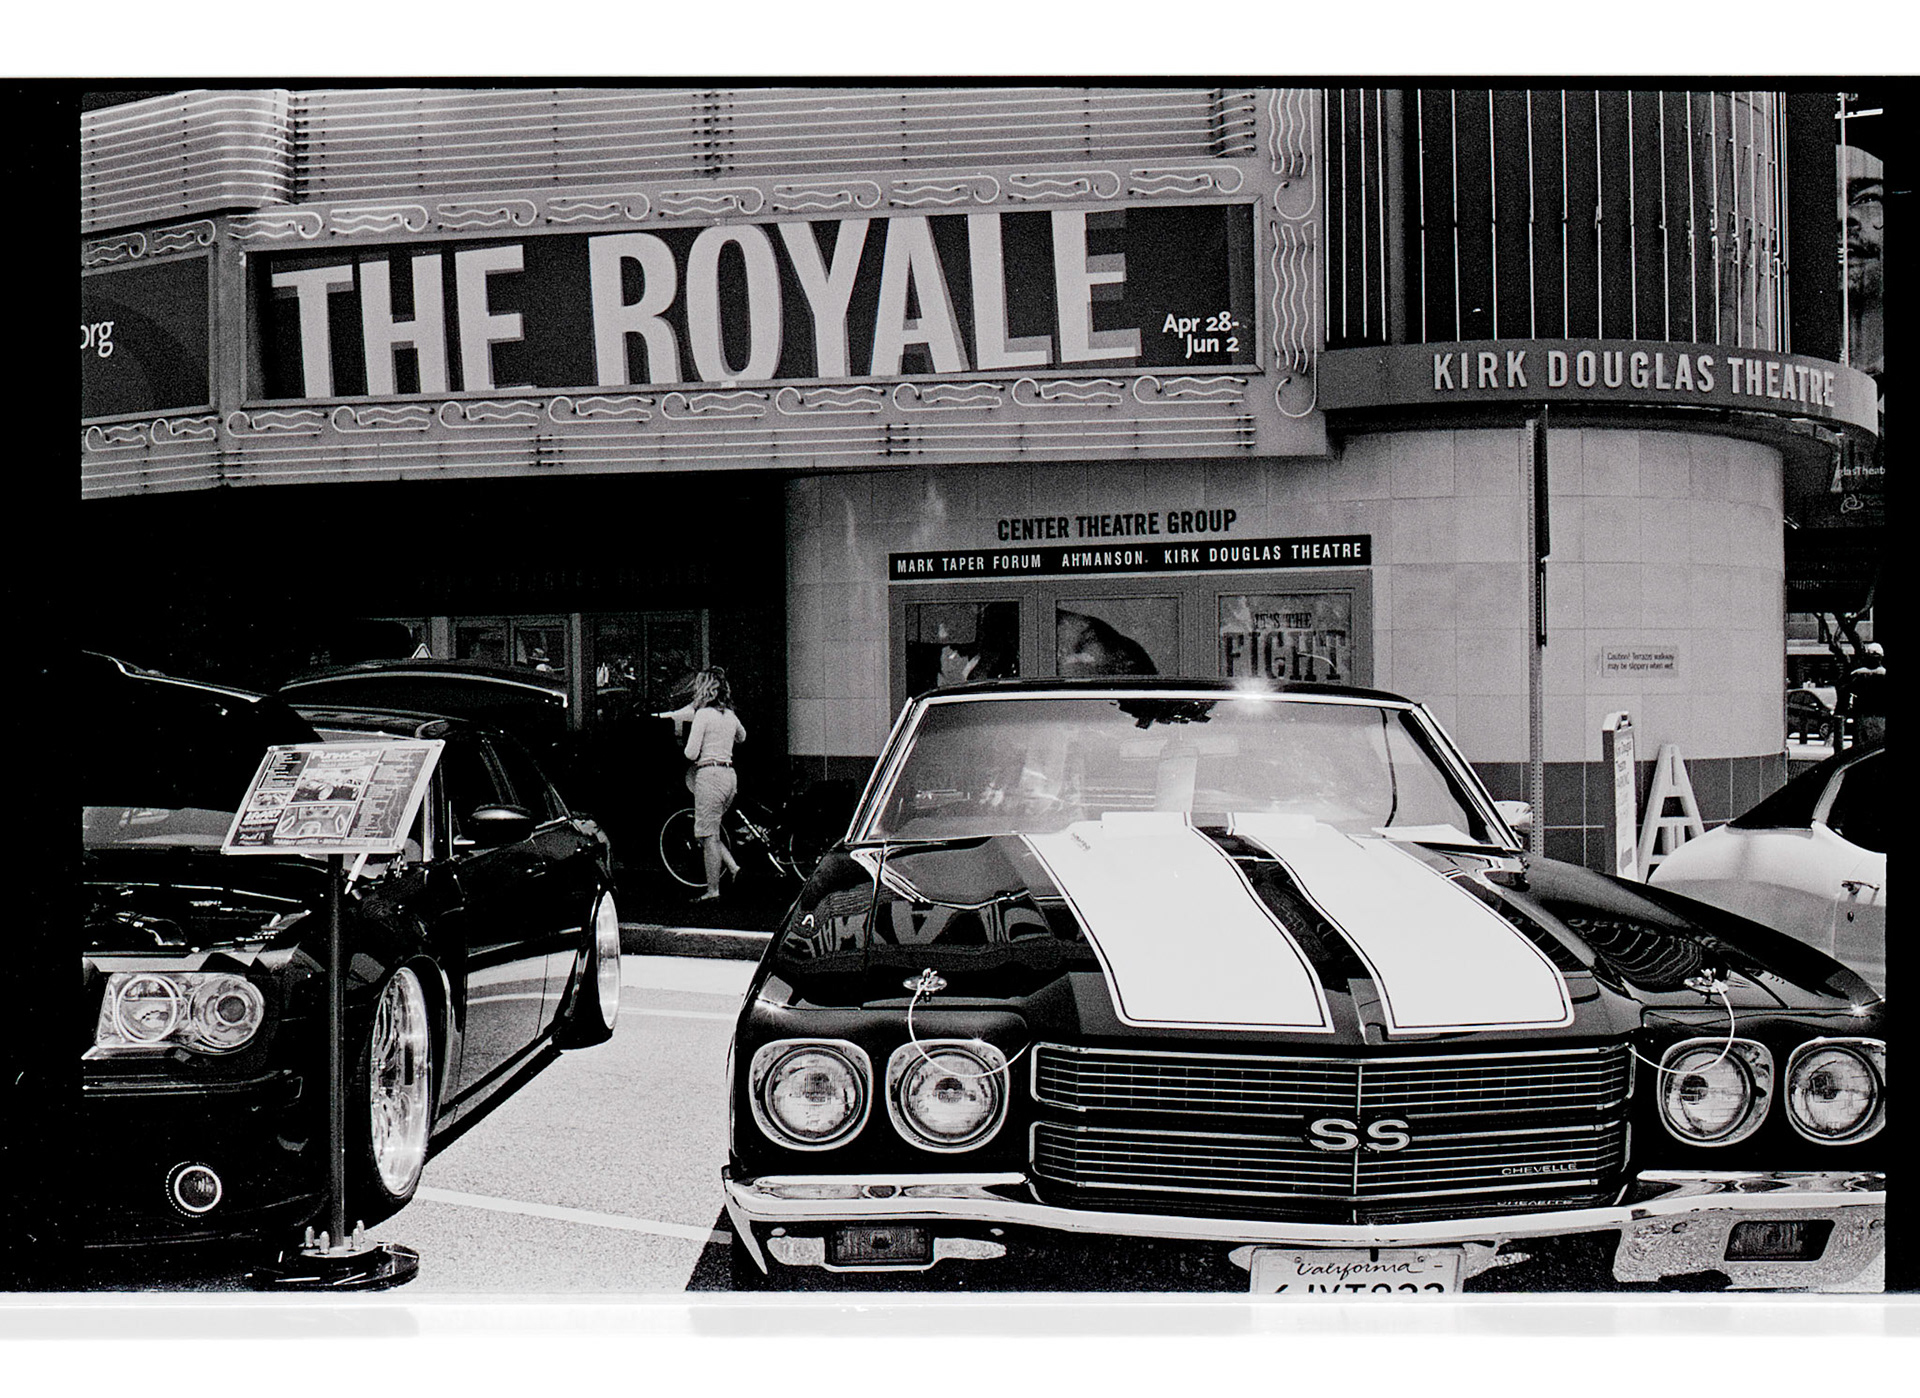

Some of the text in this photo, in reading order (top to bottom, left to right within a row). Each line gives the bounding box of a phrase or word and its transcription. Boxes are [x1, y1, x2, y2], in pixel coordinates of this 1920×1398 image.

[272, 208, 1141, 399] THE ROYALE
[1162, 313, 1200, 339] Apr
[1185, 334, 1239, 359] Jun 2
[1433, 350, 1836, 409] KIRK DOUGLAS THEATRE
[997, 509, 1237, 541] CENTER THEATRE GROUP
[898, 542, 1362, 573] MARK TAPER FORUM AHMANSON KIRK DOUGLAS THEATRE
[1254, 612, 1312, 629] IT'S THE
[1224, 630, 1346, 681] FIGHT
[1310, 1118, 1411, 1152] SS
[1501, 1163, 1577, 1175] CHEVELLE
[1297, 1262, 1423, 1280] California
